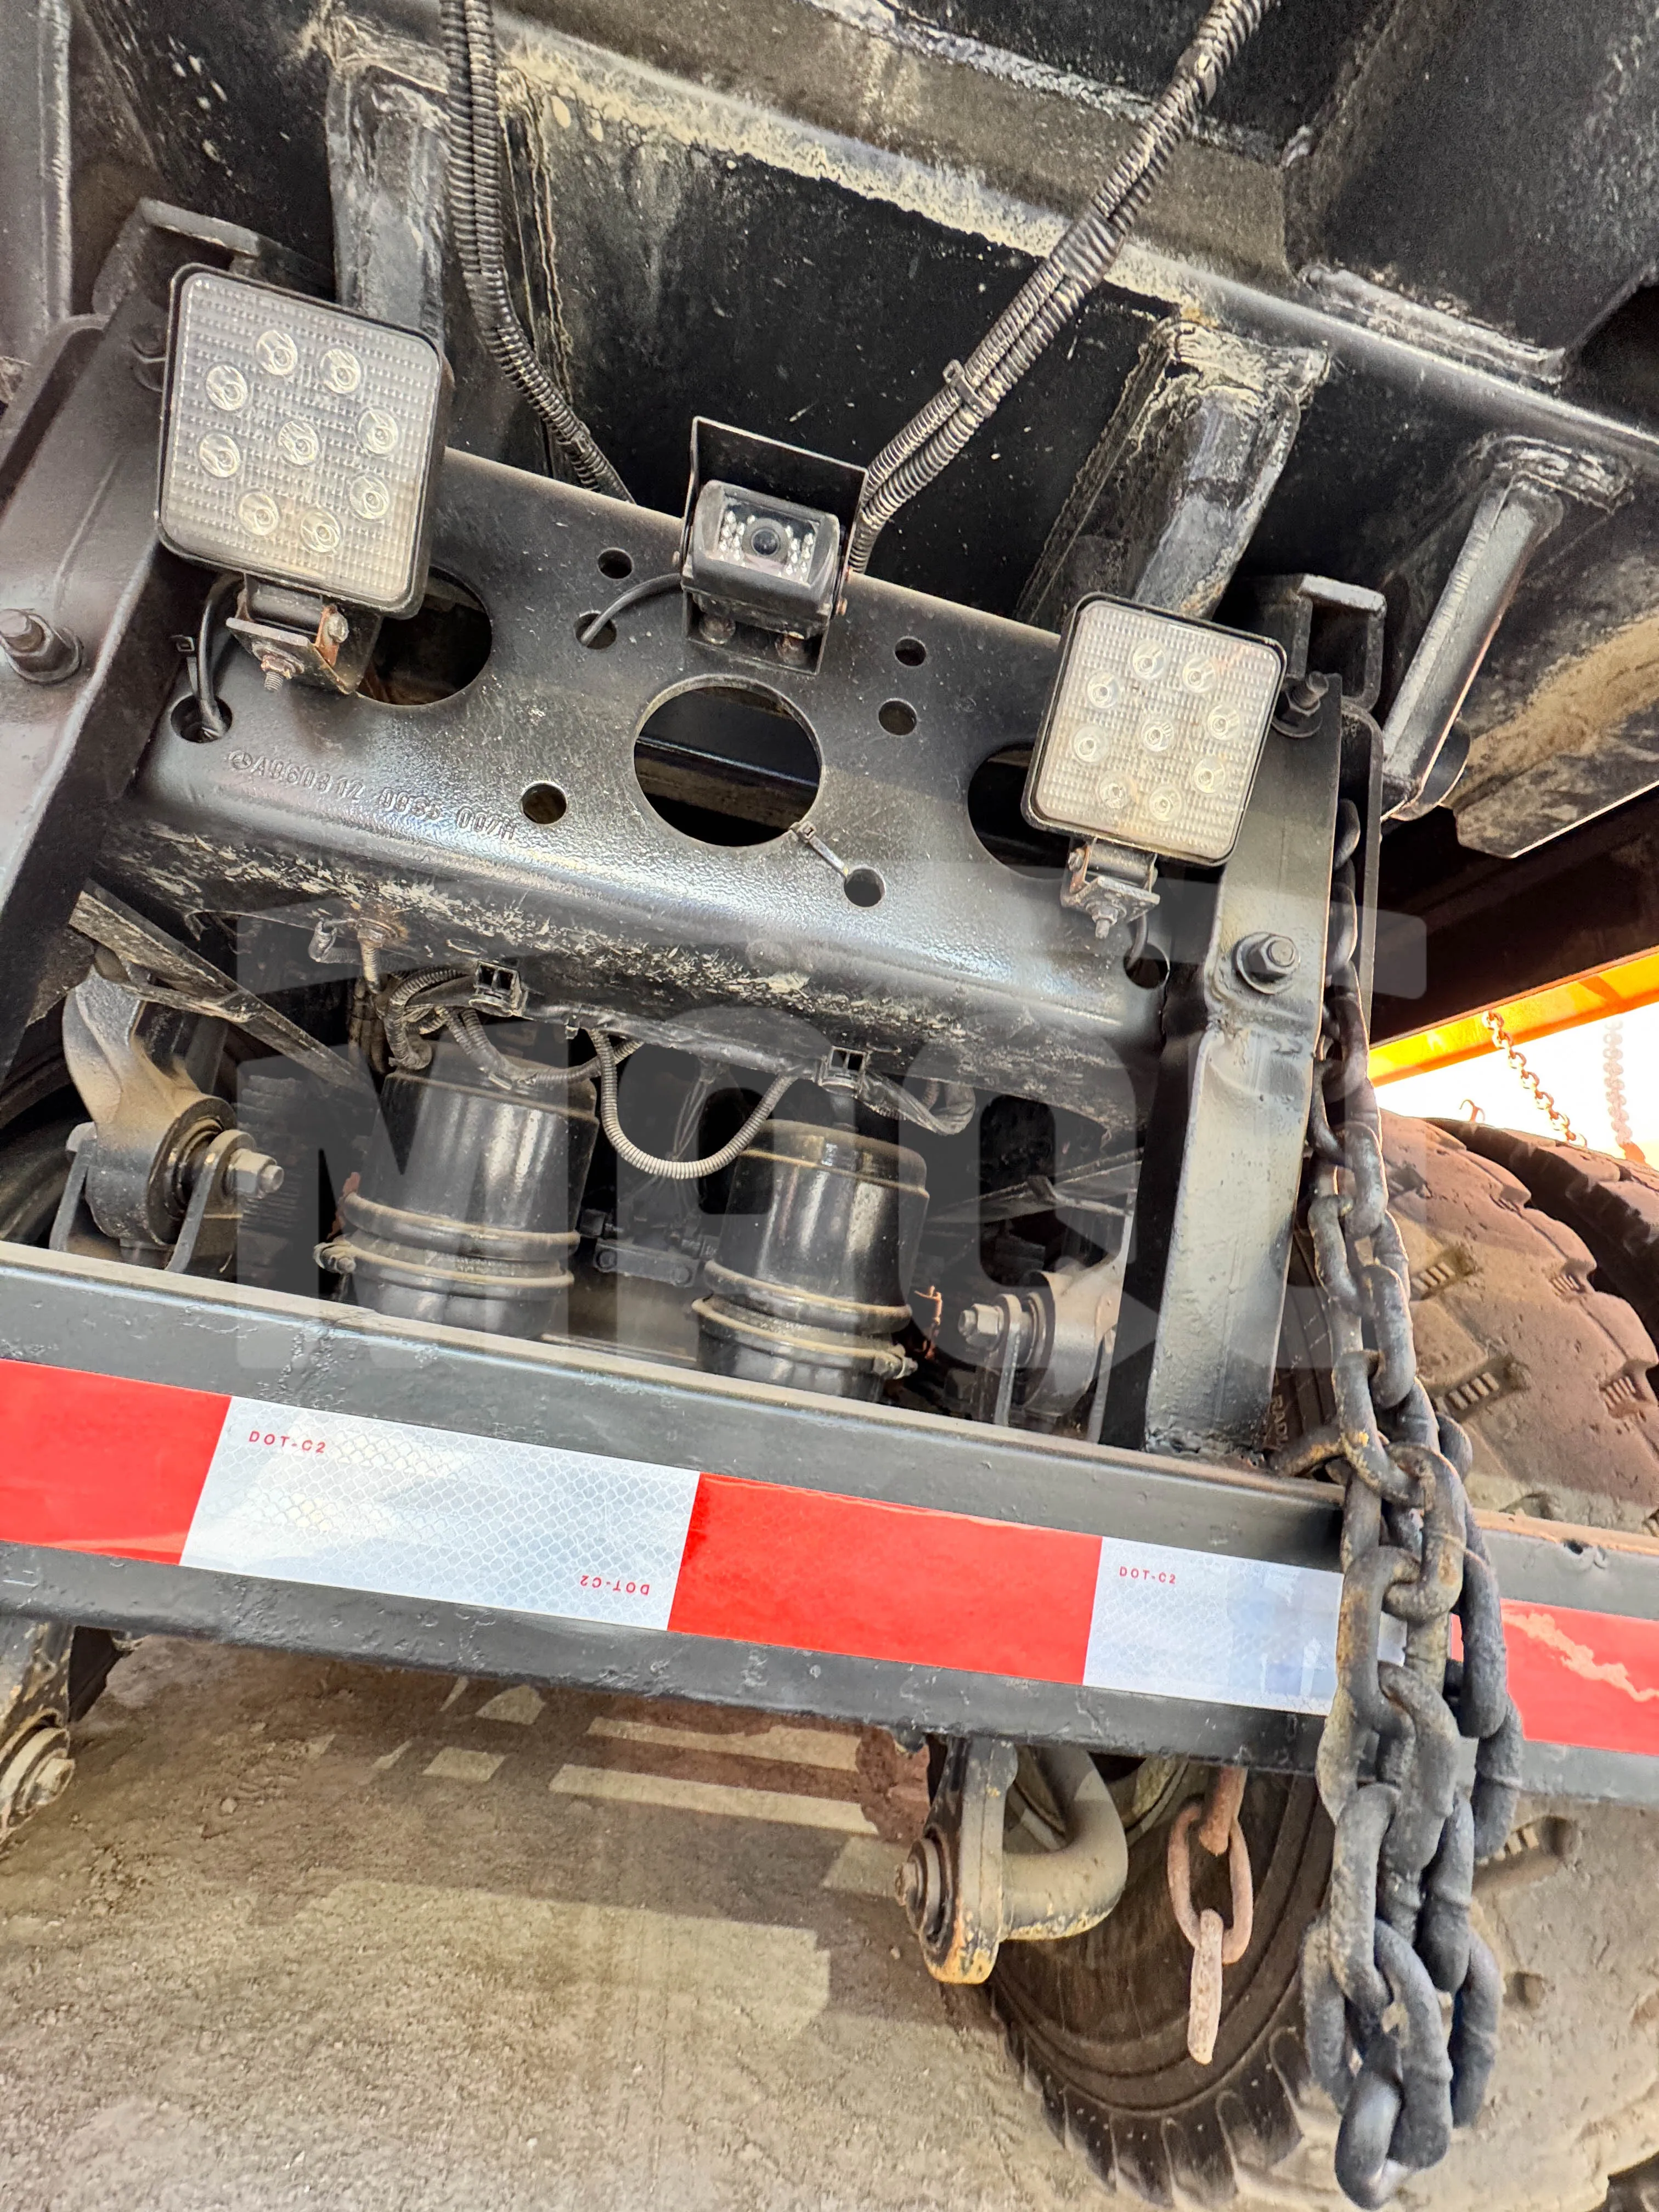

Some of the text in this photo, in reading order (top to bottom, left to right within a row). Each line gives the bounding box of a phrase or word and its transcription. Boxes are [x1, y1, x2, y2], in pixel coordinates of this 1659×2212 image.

[249, 1431, 325, 1453] DOT-C2
[580, 1575, 650, 1595] DOT-C2
[1120, 1567, 1175, 1583] DOT-C2
